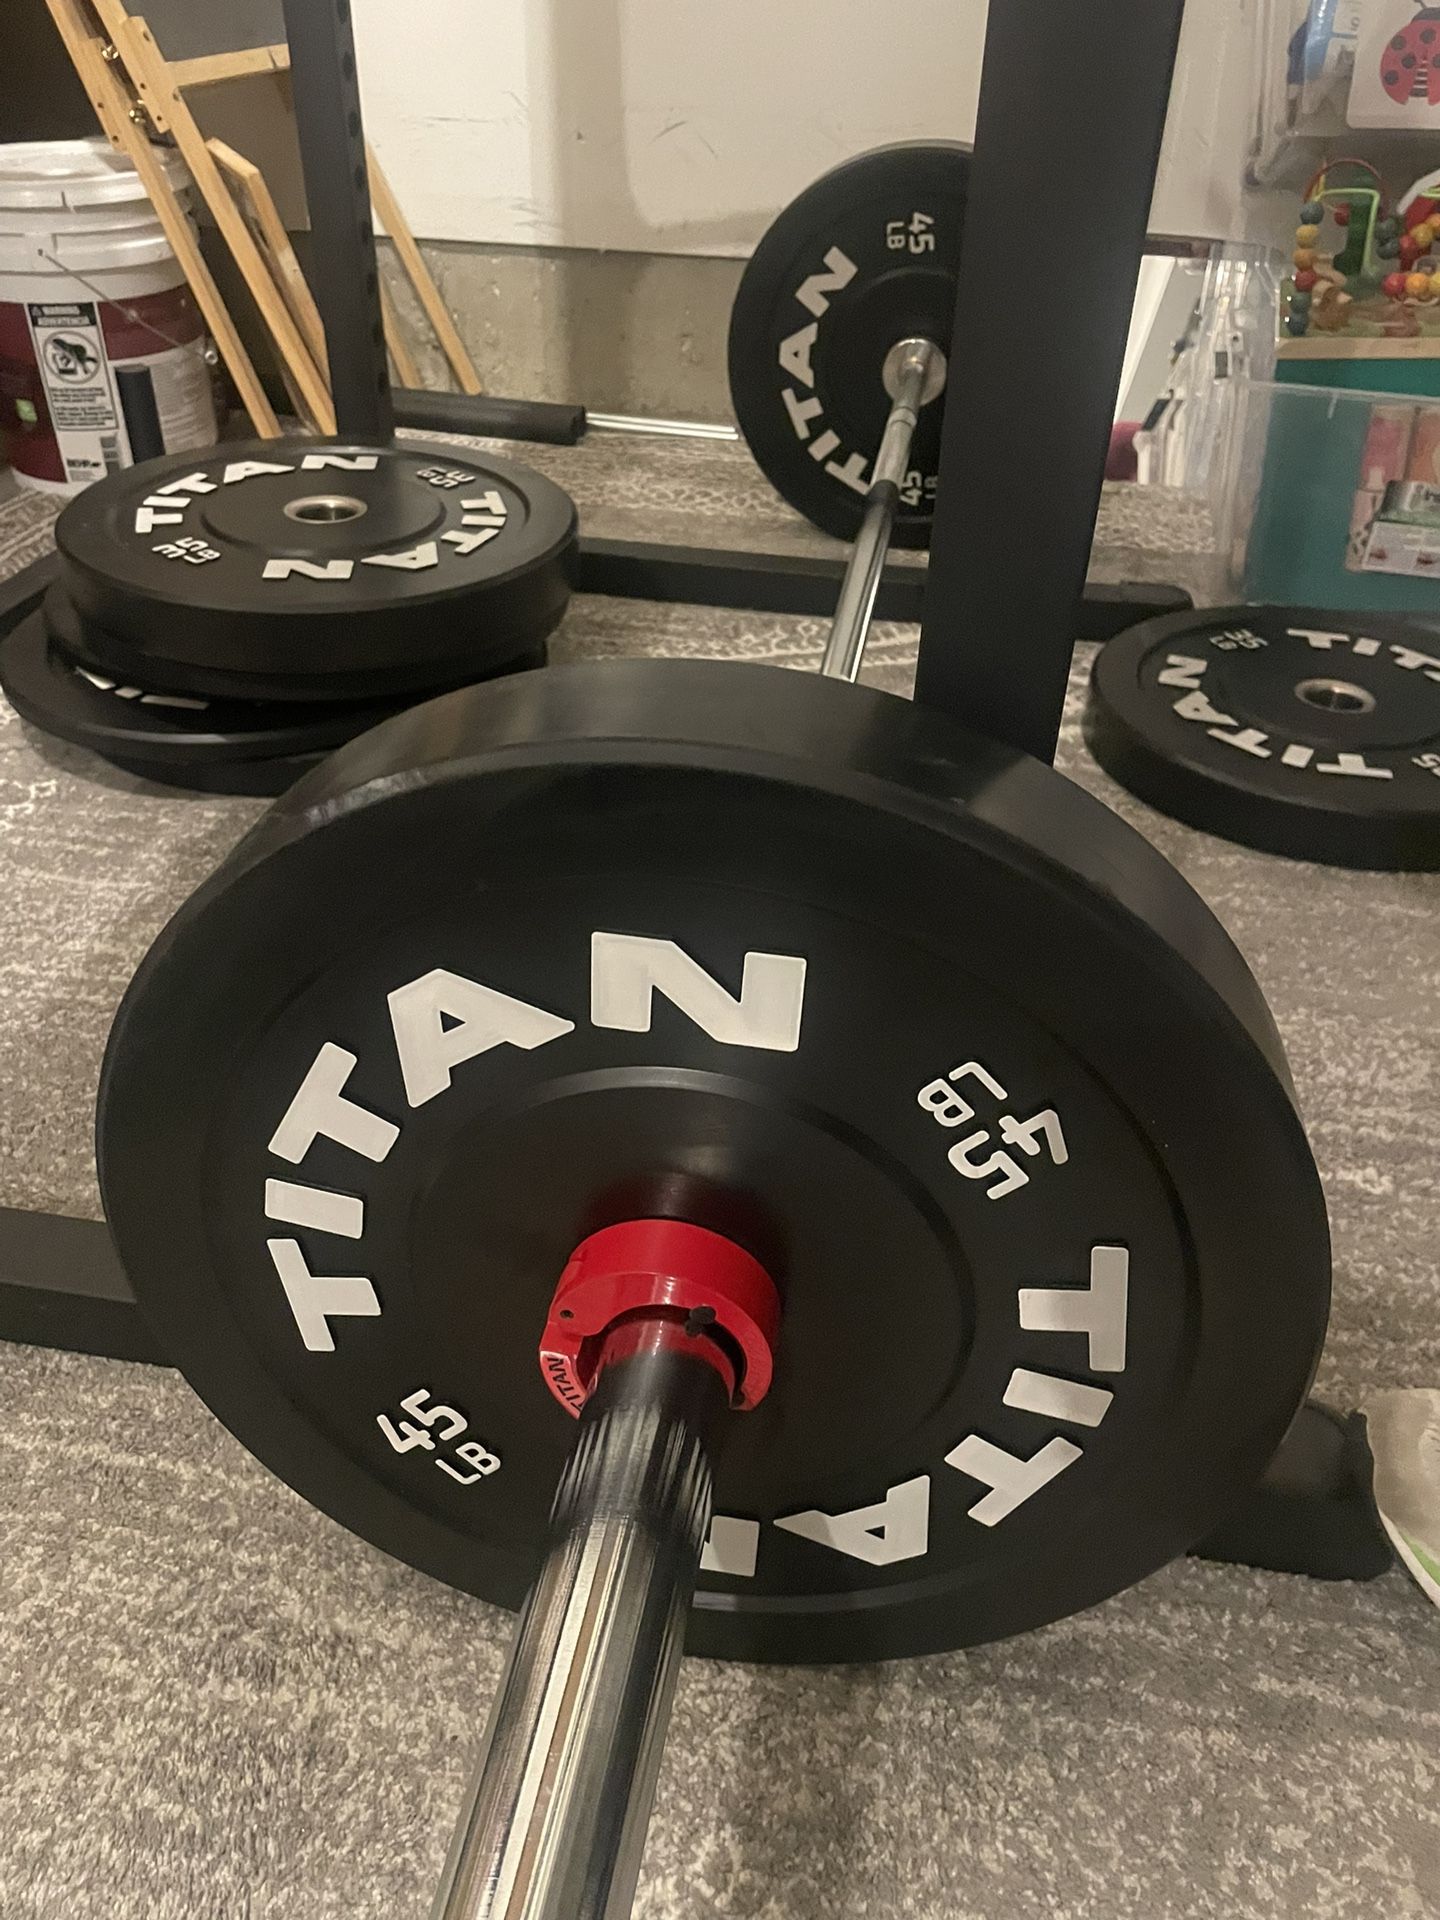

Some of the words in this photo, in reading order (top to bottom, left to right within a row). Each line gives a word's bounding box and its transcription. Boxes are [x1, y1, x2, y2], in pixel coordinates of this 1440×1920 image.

[886, 221, 906, 249] LB
[908, 211, 934, 254] 45
[779, 246, 872, 495] TITAN
[135, 454, 378, 533] TITAN
[429, 470, 476, 488] 35
[900, 471, 922, 506] 45
[151, 537, 208, 558] 35
[182, 549, 221, 564] LB
[262, 490, 508, 580] TITAN
[1287, 629, 1440, 682] TIT
[1158, 654, 1394, 779] TITAN
[917, 1061, 1008, 1128] LB
[264, 931, 807, 1352] TITAN
[947, 1109, 1069, 1200] 45
[376, 1388, 468, 1454] 45
[434, 1441, 501, 1485] LB
